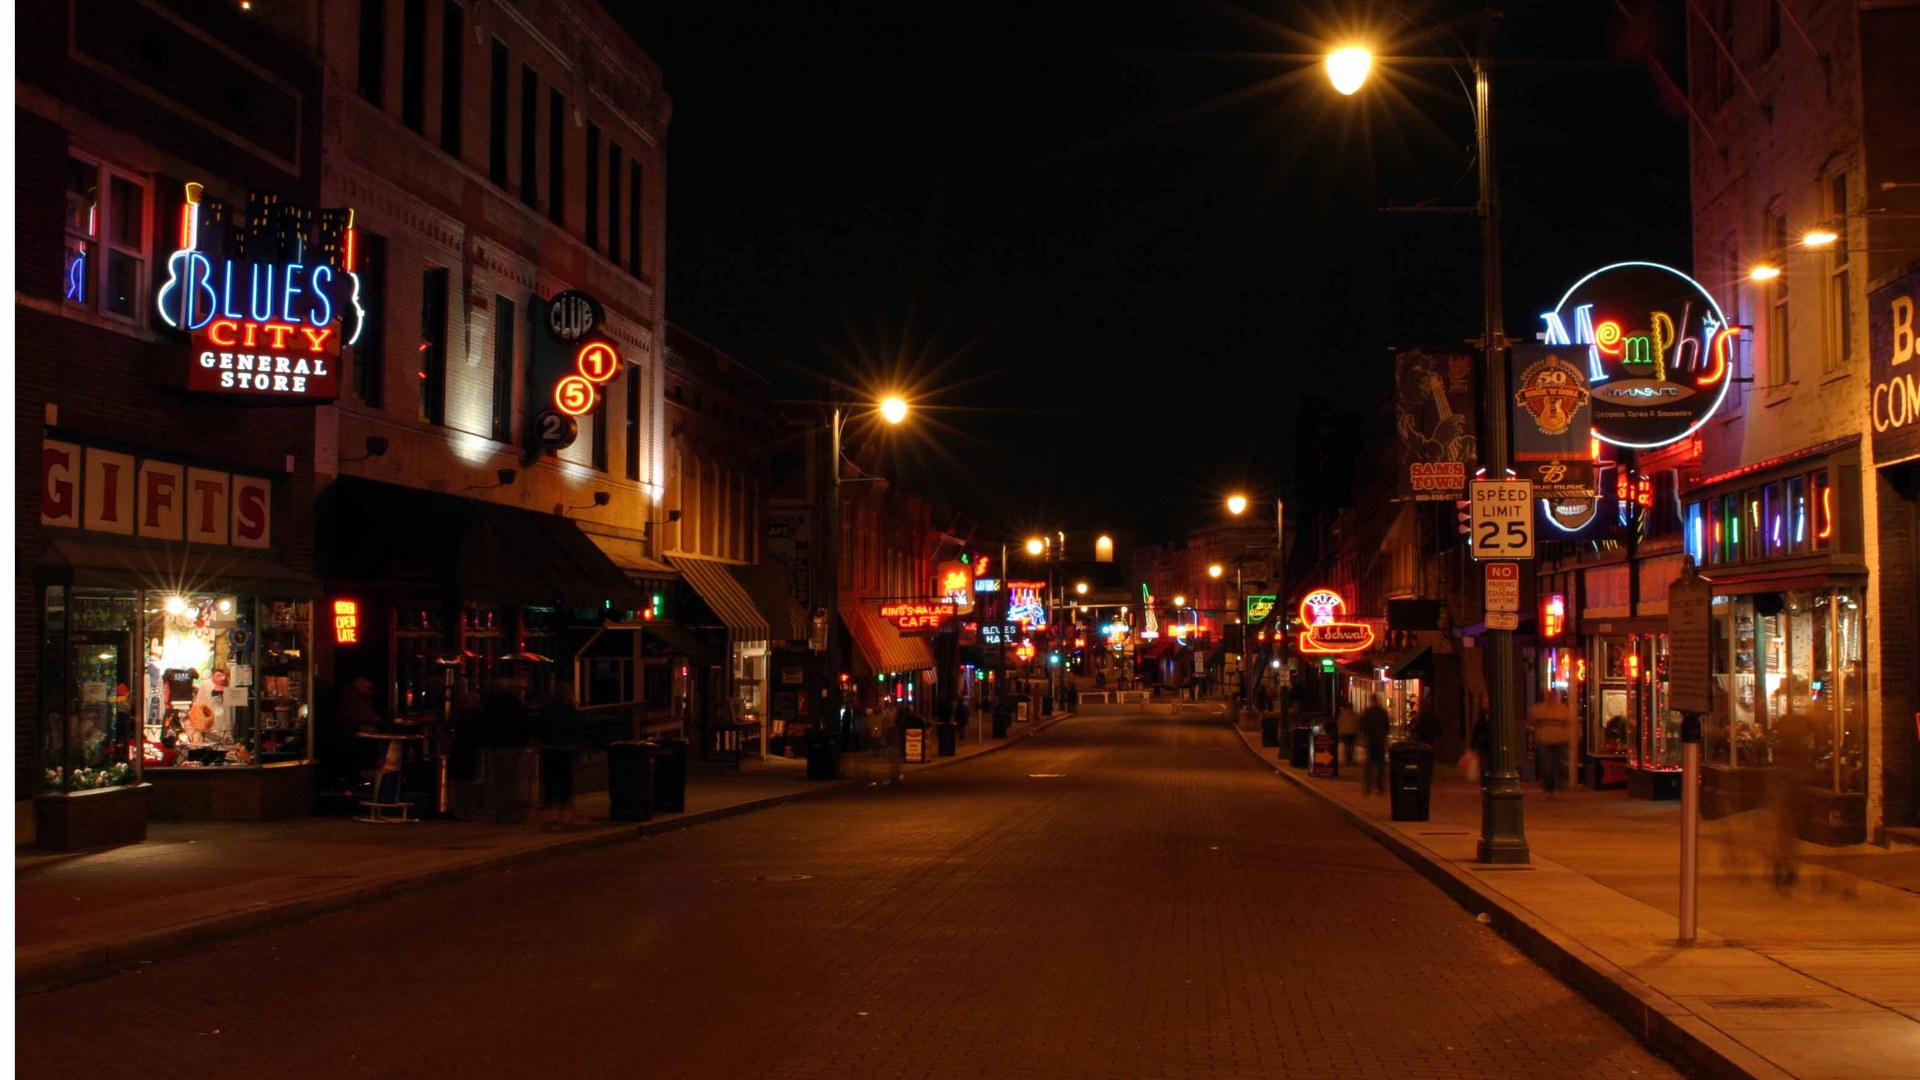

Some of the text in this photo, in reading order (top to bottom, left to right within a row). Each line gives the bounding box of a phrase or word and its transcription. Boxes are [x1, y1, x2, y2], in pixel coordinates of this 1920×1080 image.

[189, 253, 332, 329] BLUES
[550, 296, 593, 339] CLUB
[208, 320, 334, 351] CITY
[200, 351, 328, 376] GENERAL
[588, 350, 603, 375] 1
[221, 371, 307, 393] STORE
[1538, 371, 1567, 385] 50
[564, 383, 585, 407] 5
[543, 415, 562, 440] 2
[1411, 462, 1465, 476] SAM'S
[1411, 476, 1465, 490] TOWN
[41, 447, 267, 540] GIFTS
[1476, 490, 1528, 502] SPEED
[1482, 506, 1522, 517] LIMIT
[1479, 521, 1528, 549] 25
[1492, 567, 1511, 577] NO
[881, 604, 954, 616] KING'S PALACE
[336, 616, 356, 628] OPEN
[898, 616, 938, 627] CAFE
[337, 628, 357, 642] LATE
[1326, 627, 1368, 640] Schwab
